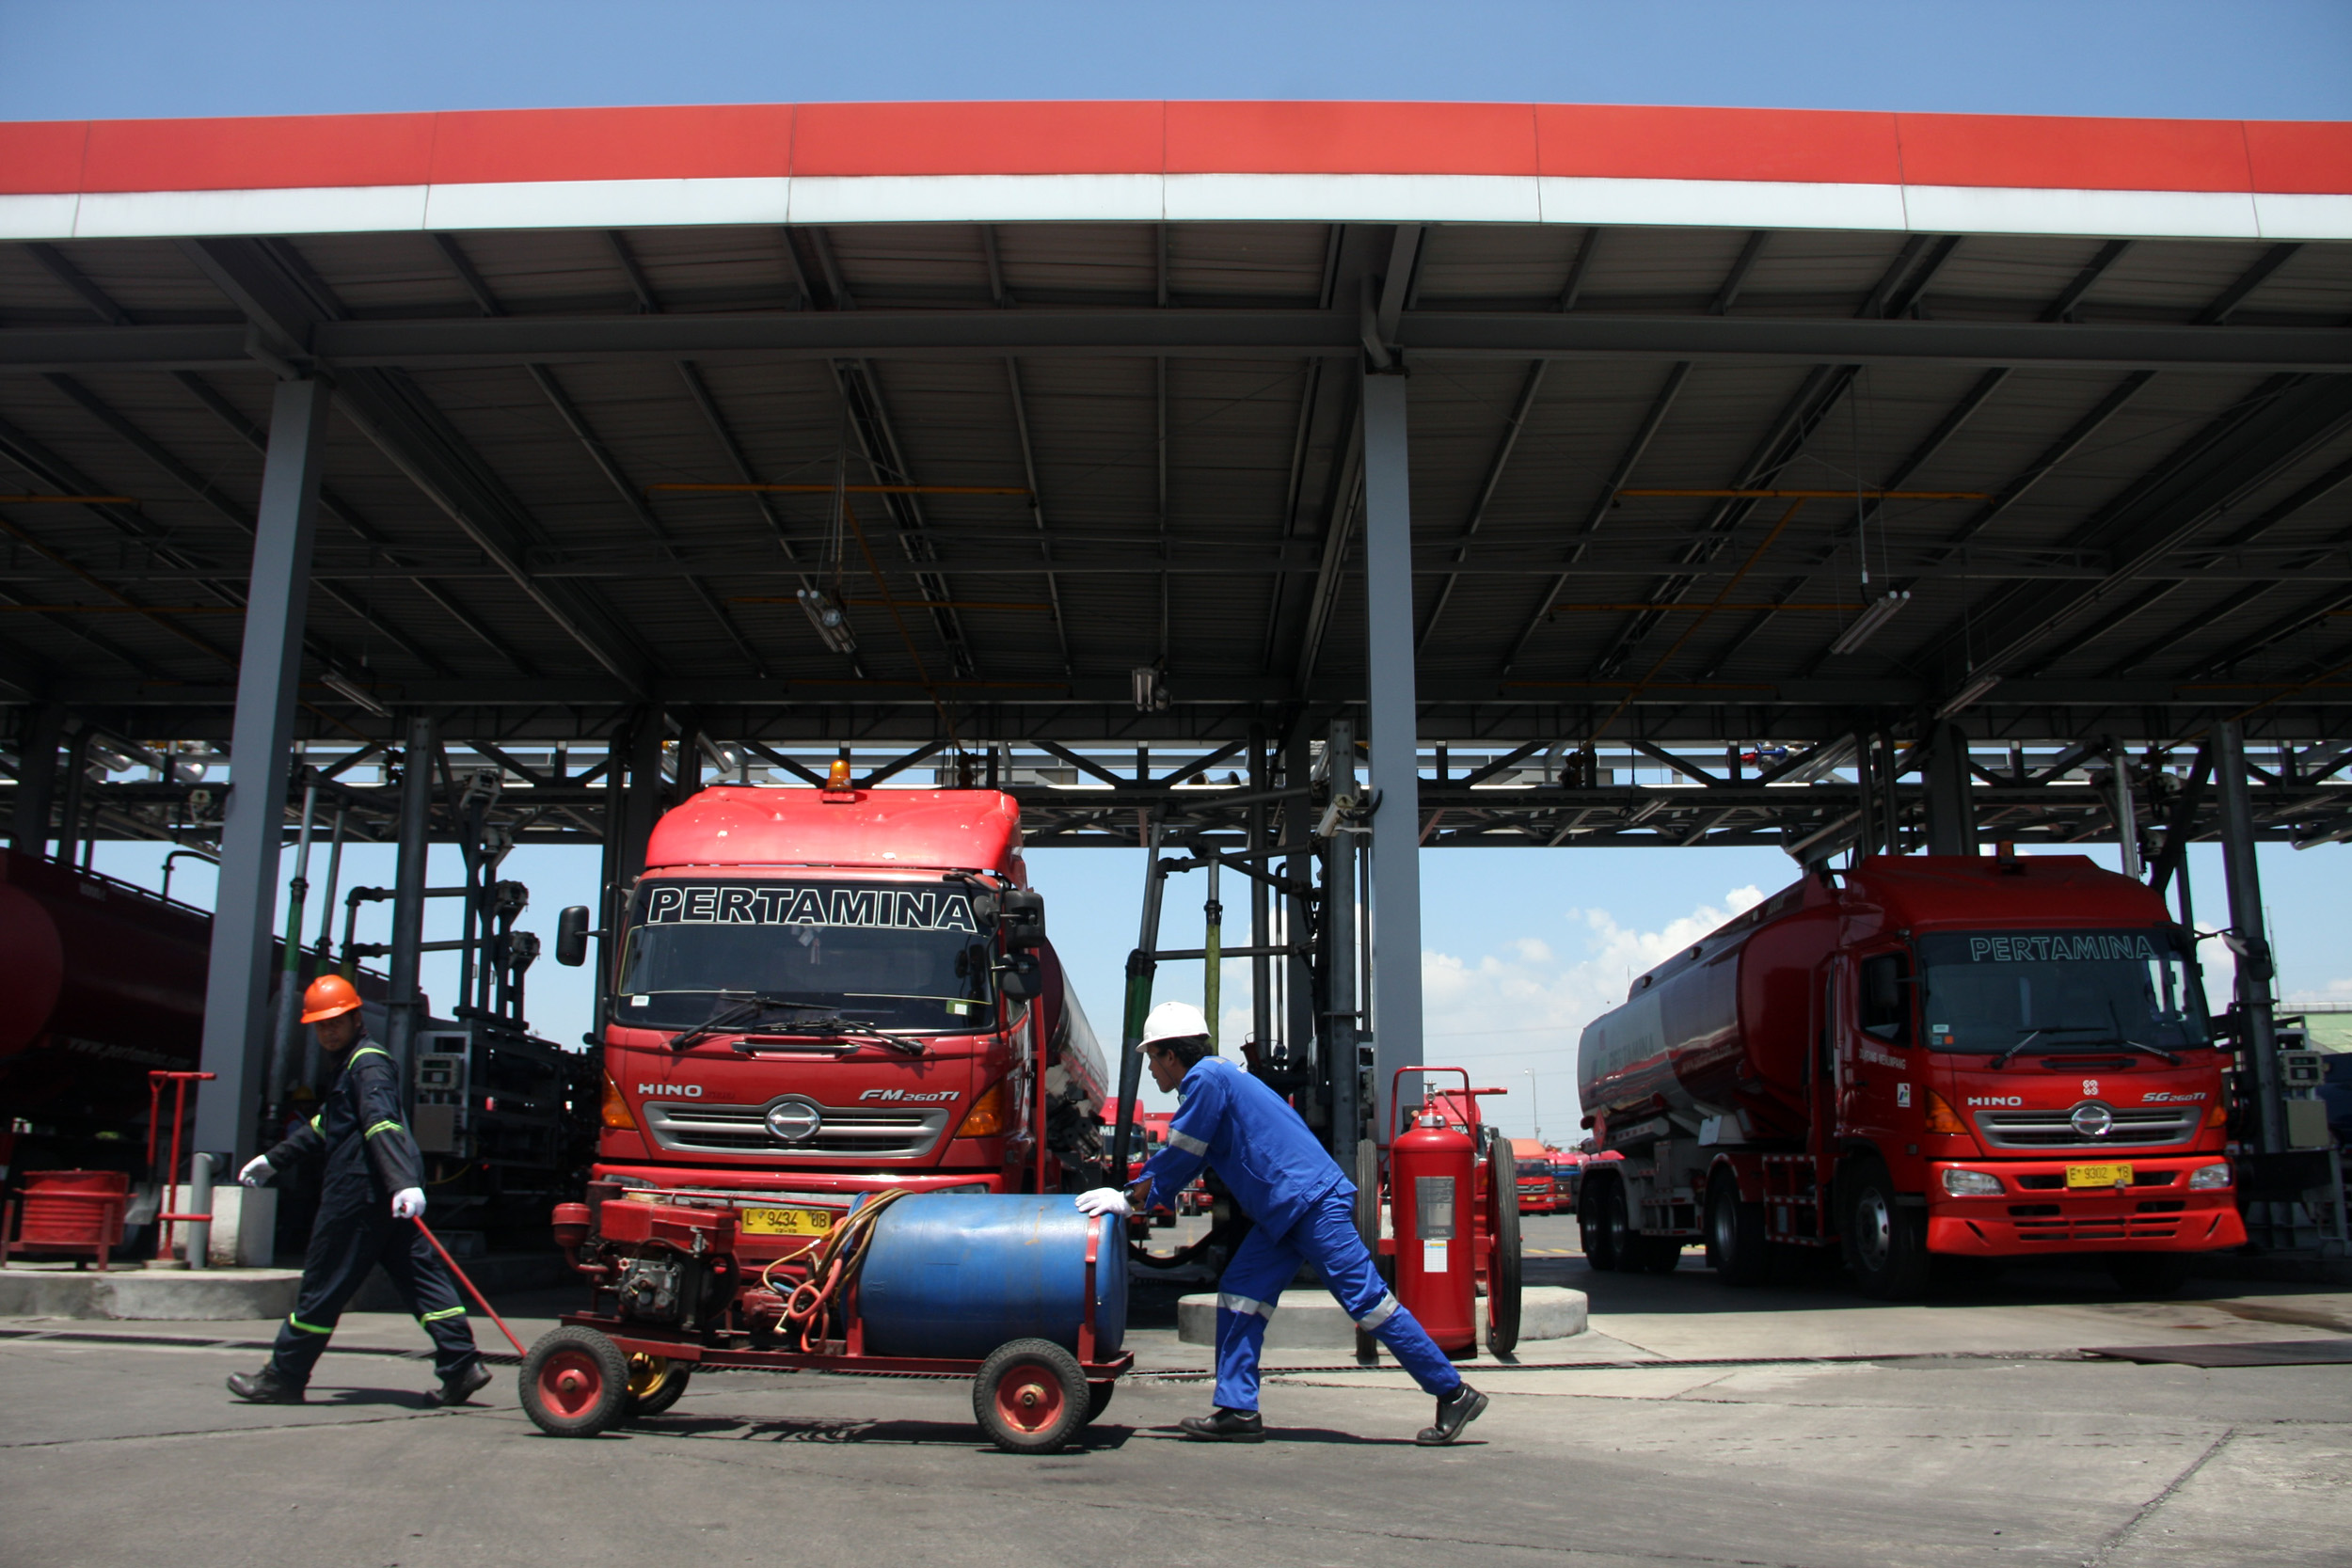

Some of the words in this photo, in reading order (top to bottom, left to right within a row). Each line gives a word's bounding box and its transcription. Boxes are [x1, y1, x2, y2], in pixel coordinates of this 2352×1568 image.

[647, 887, 977, 933] PERTAMINA
[1970, 936, 2155, 961] PERTAMINA
[638, 1083, 703, 1098] HINO
[1967, 1096, 2022, 1106] HINO
[2070, 1168, 2075, 1180] E
[2084, 1167, 2107, 1180] 9302
[747, 1211, 753, 1226] L
[768, 1211, 798, 1227] 9434
[811, 1212, 828, 1227] UB
